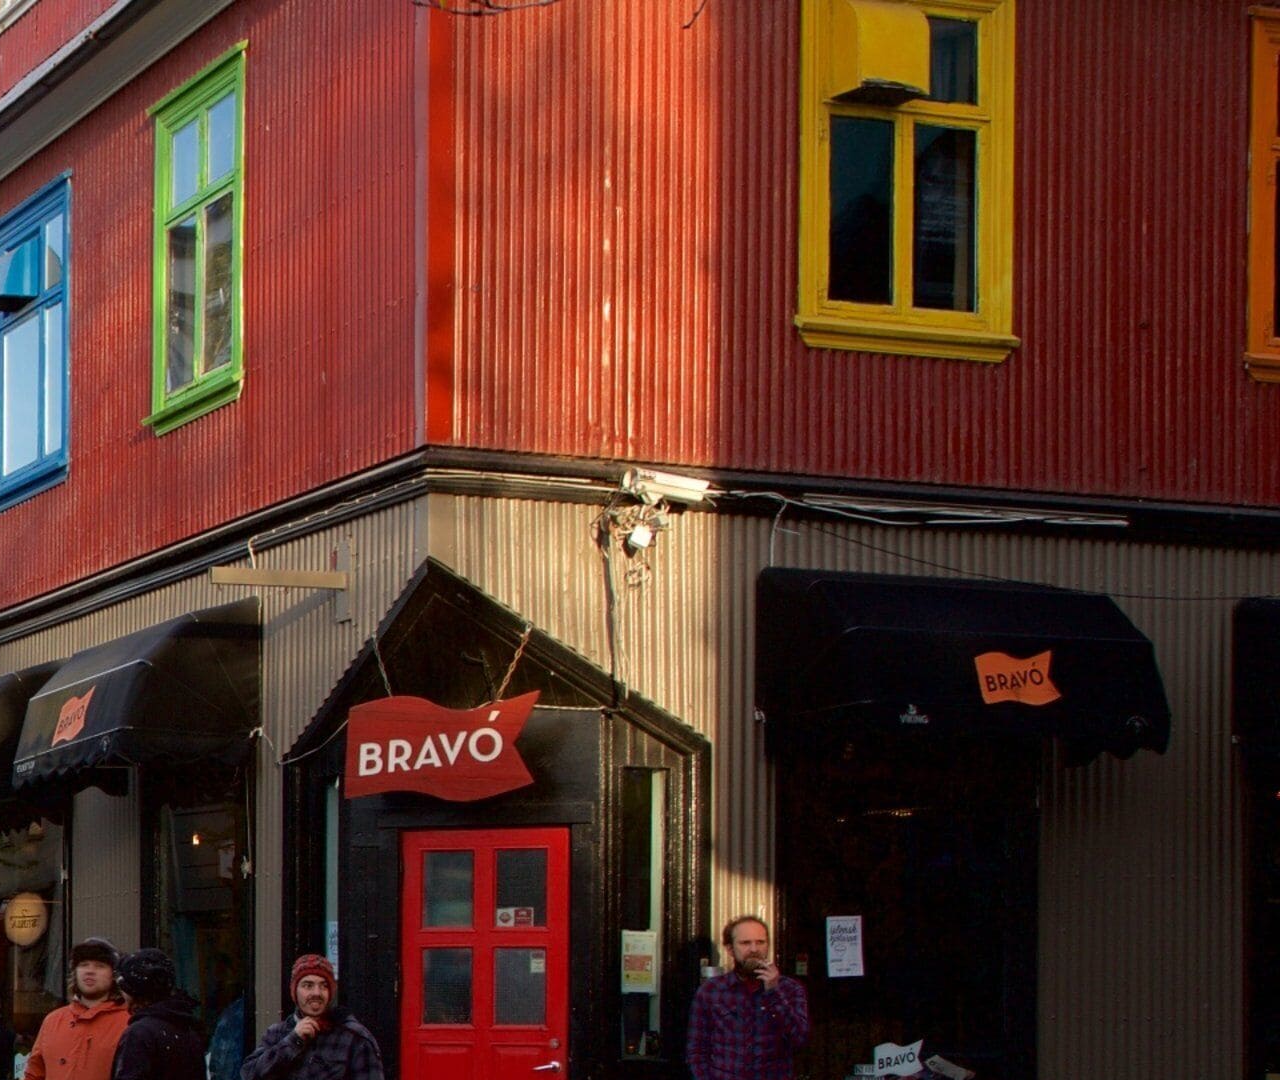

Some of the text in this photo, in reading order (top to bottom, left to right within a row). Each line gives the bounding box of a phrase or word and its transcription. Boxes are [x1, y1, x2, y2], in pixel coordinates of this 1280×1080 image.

[985, 662, 1044, 693] BRAVÓ
[359, 711, 503, 777] BRAVÓ
[878, 1047, 916, 1070] BRAVÓ
